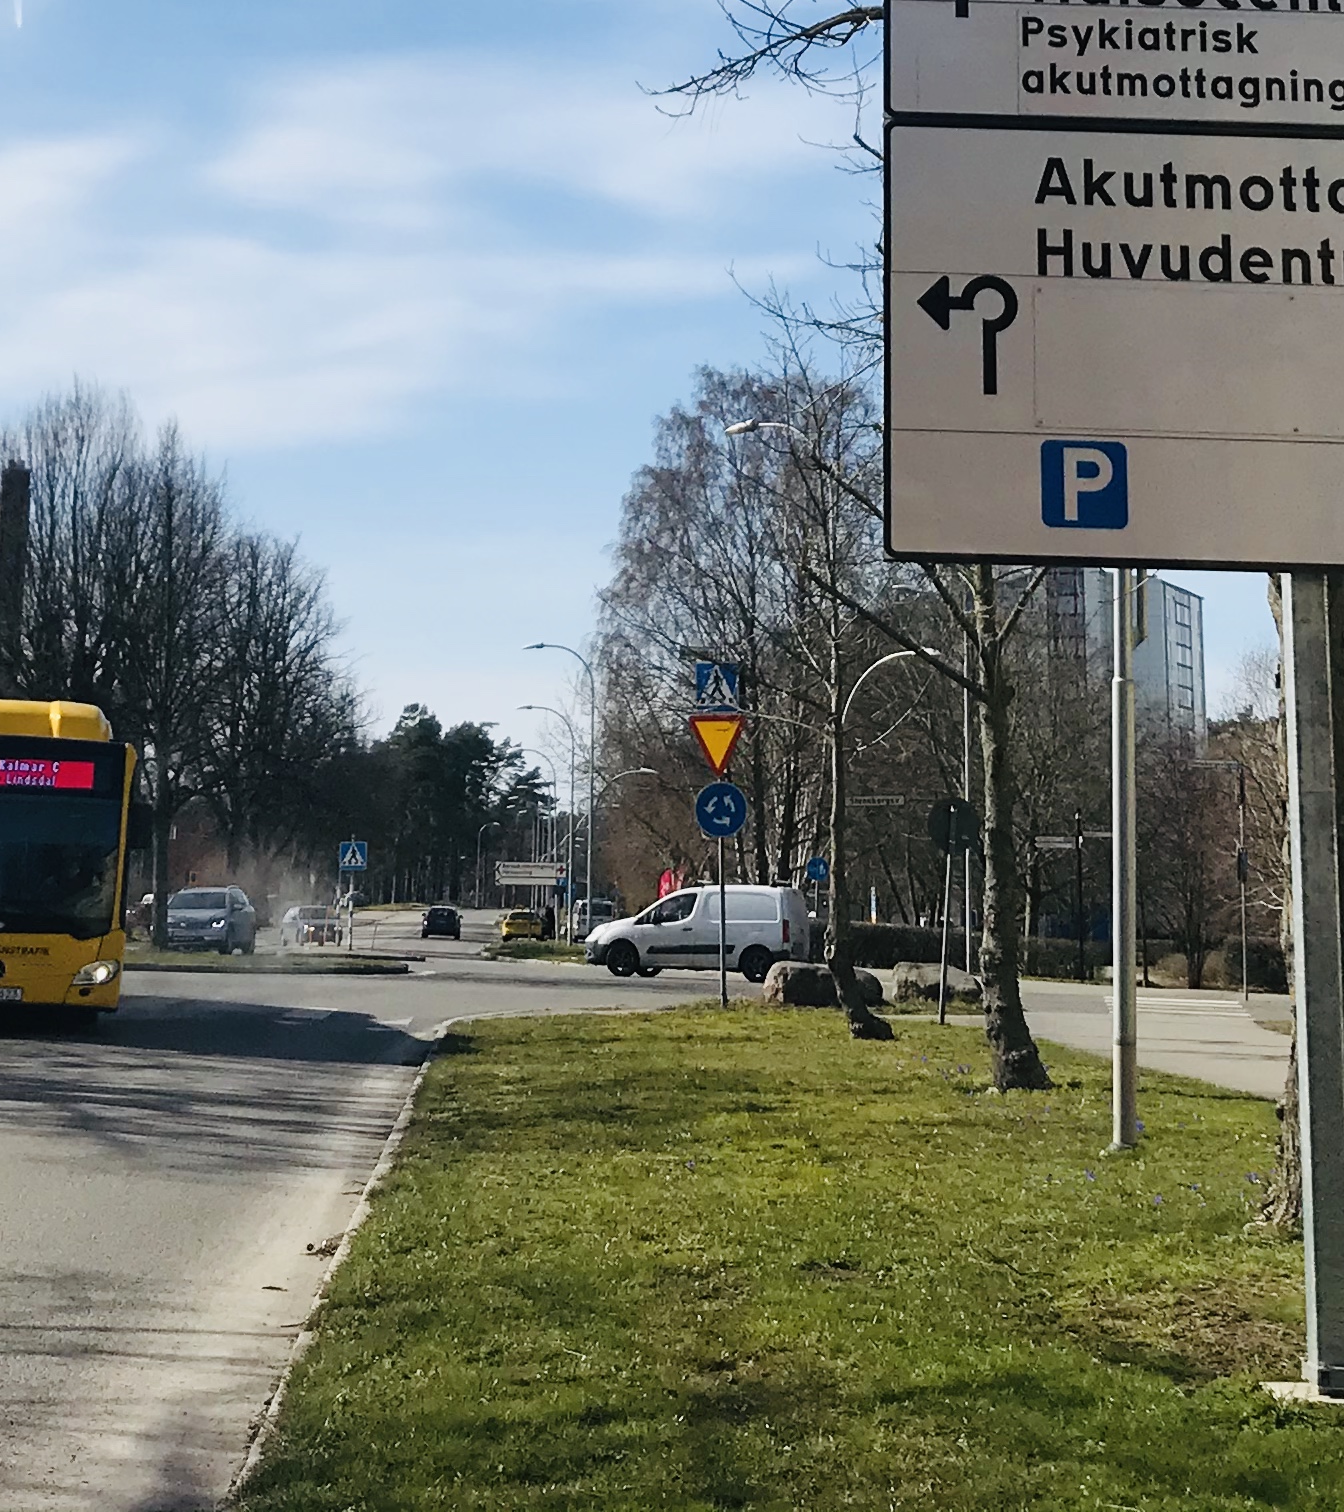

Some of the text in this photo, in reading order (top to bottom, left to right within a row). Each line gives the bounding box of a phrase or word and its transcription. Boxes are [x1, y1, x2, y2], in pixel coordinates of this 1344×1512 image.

[1021, 16, 1259, 57] Psykiatrisk
[1062, 446, 1114, 521] P
[6, 774, 56, 786] Lindsdal
[52, 761, 60, 773] C
